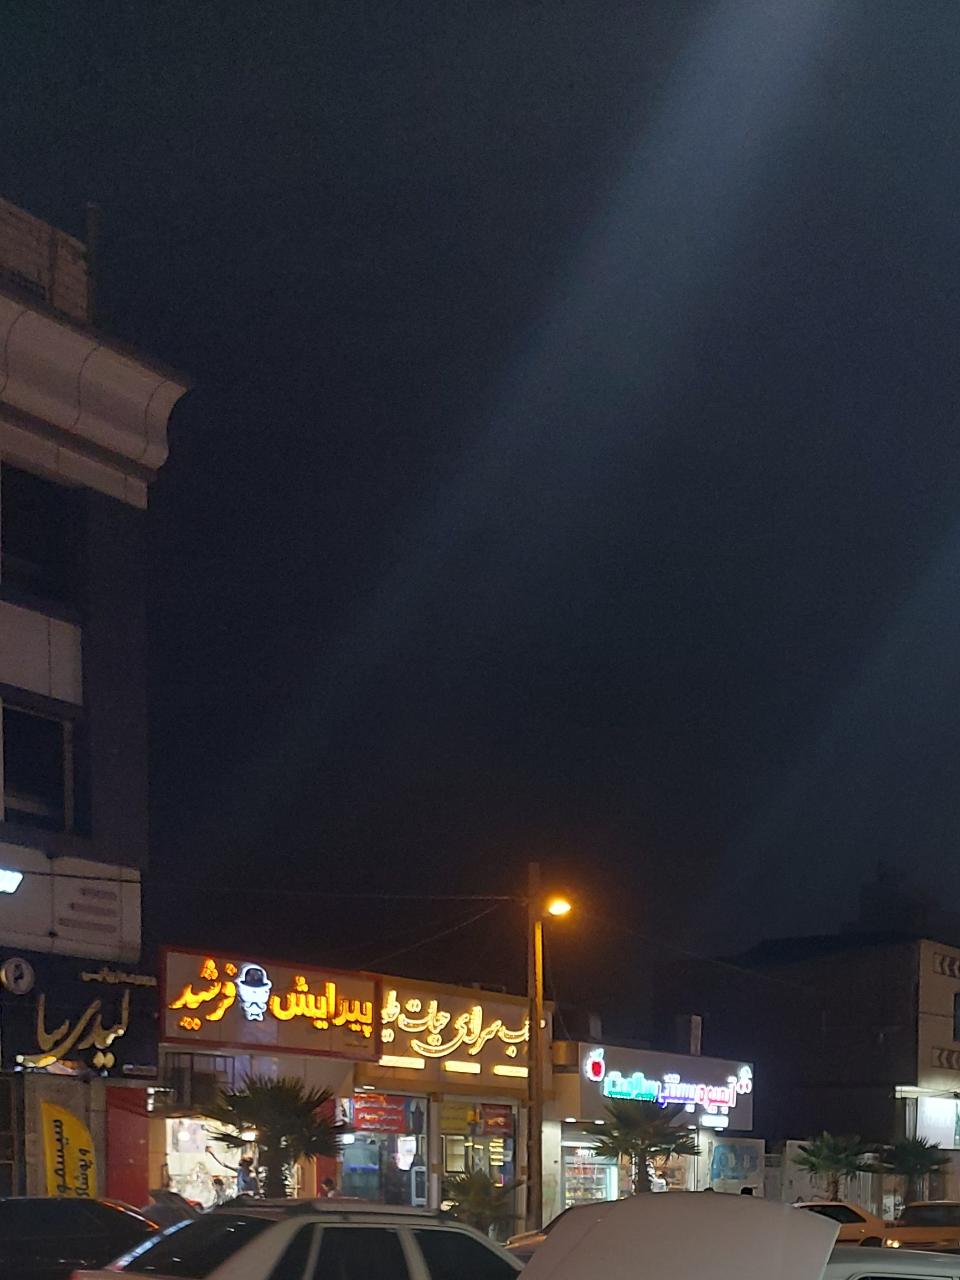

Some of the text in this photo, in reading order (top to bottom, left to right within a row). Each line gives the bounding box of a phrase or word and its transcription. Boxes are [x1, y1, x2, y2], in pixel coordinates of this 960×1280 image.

[168, 958, 373, 1038] پیرایش فرشید
[53, 1119, 73, 1194] سیسمو
